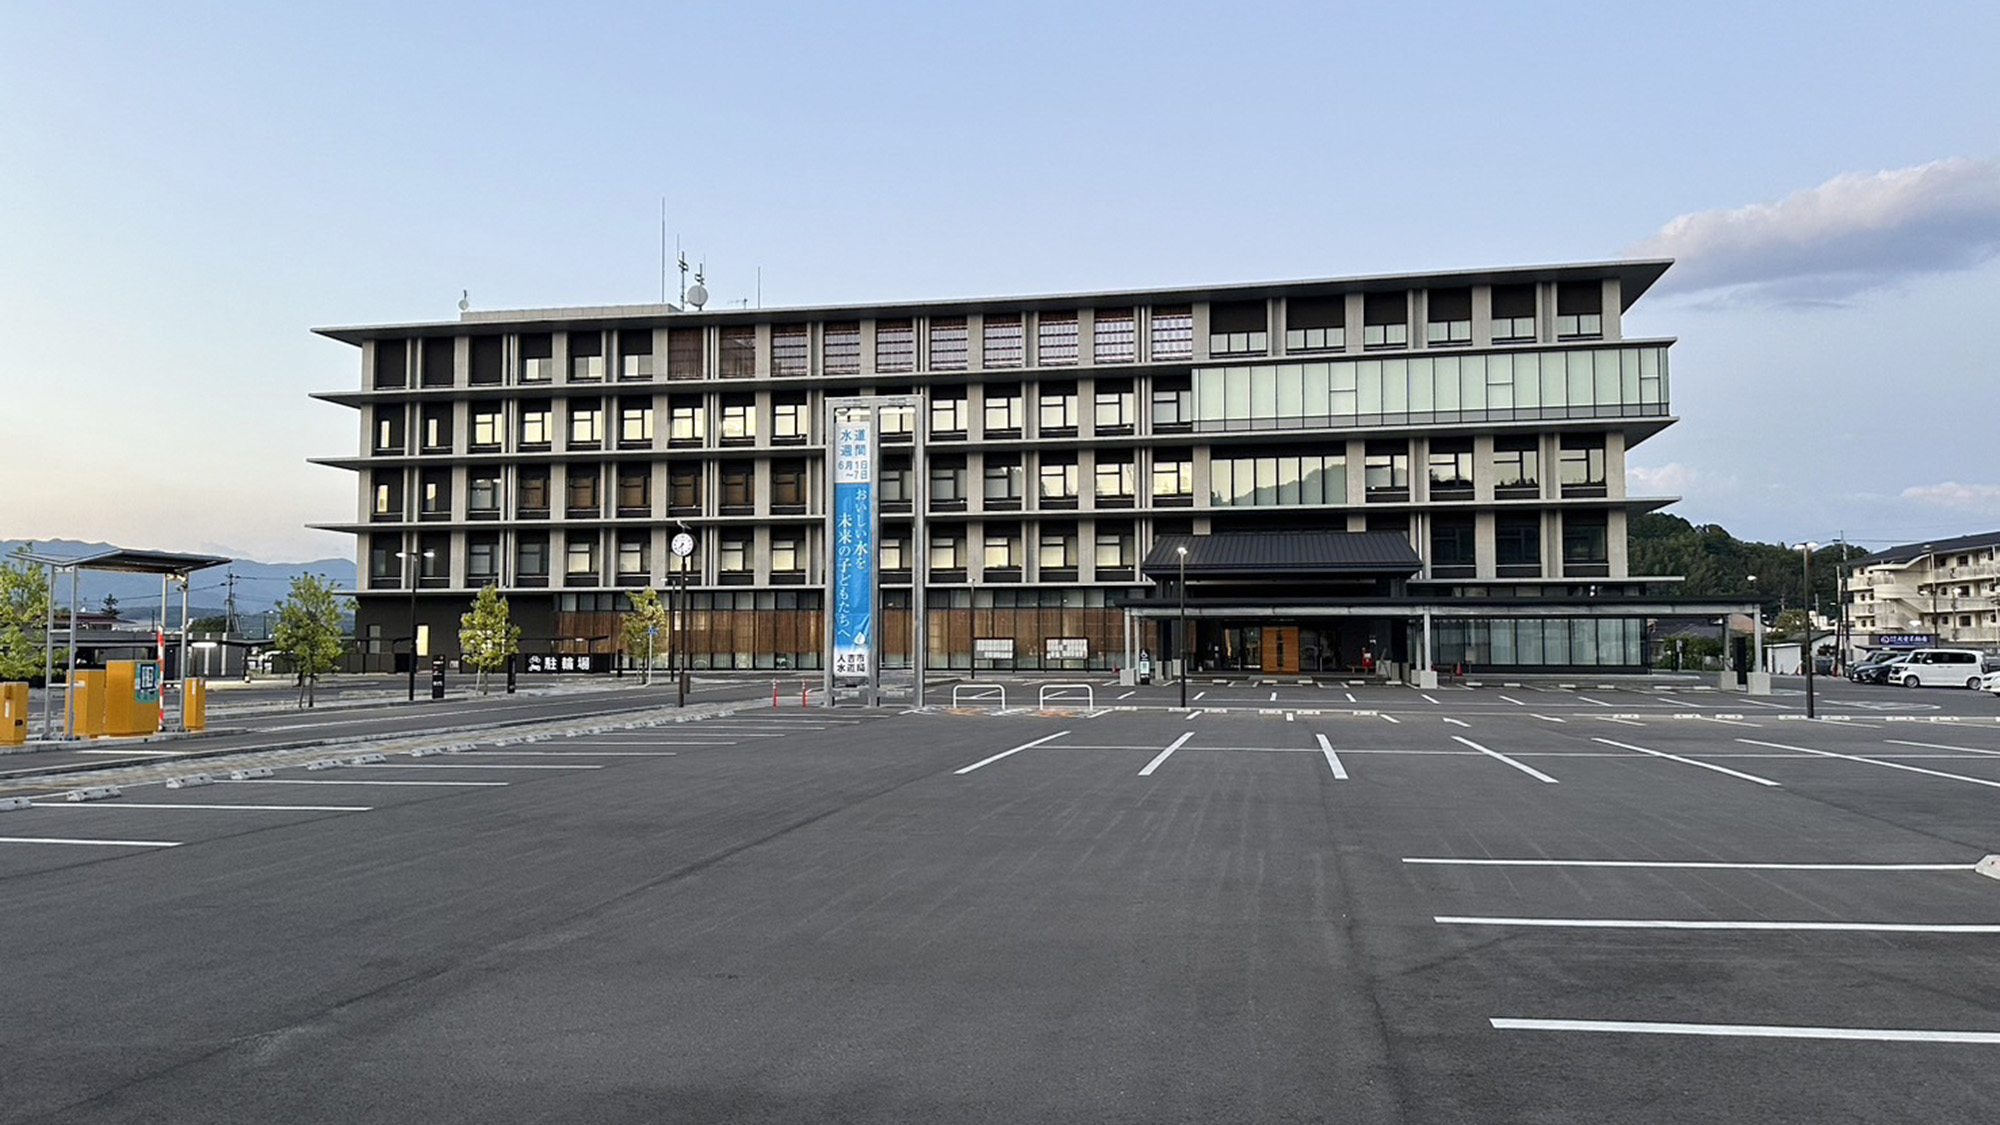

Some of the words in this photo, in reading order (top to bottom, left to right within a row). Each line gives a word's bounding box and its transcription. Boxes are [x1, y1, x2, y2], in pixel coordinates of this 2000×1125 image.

[840, 429, 866, 441] 水道
[840, 444, 866, 457] 週間
[838, 460, 868, 470] 6月1日
[853, 488, 868, 570] おいしい水を
[837, 512, 853, 638] 未来の子どもたちへ
[543, 656, 590, 670] 駐輪場
